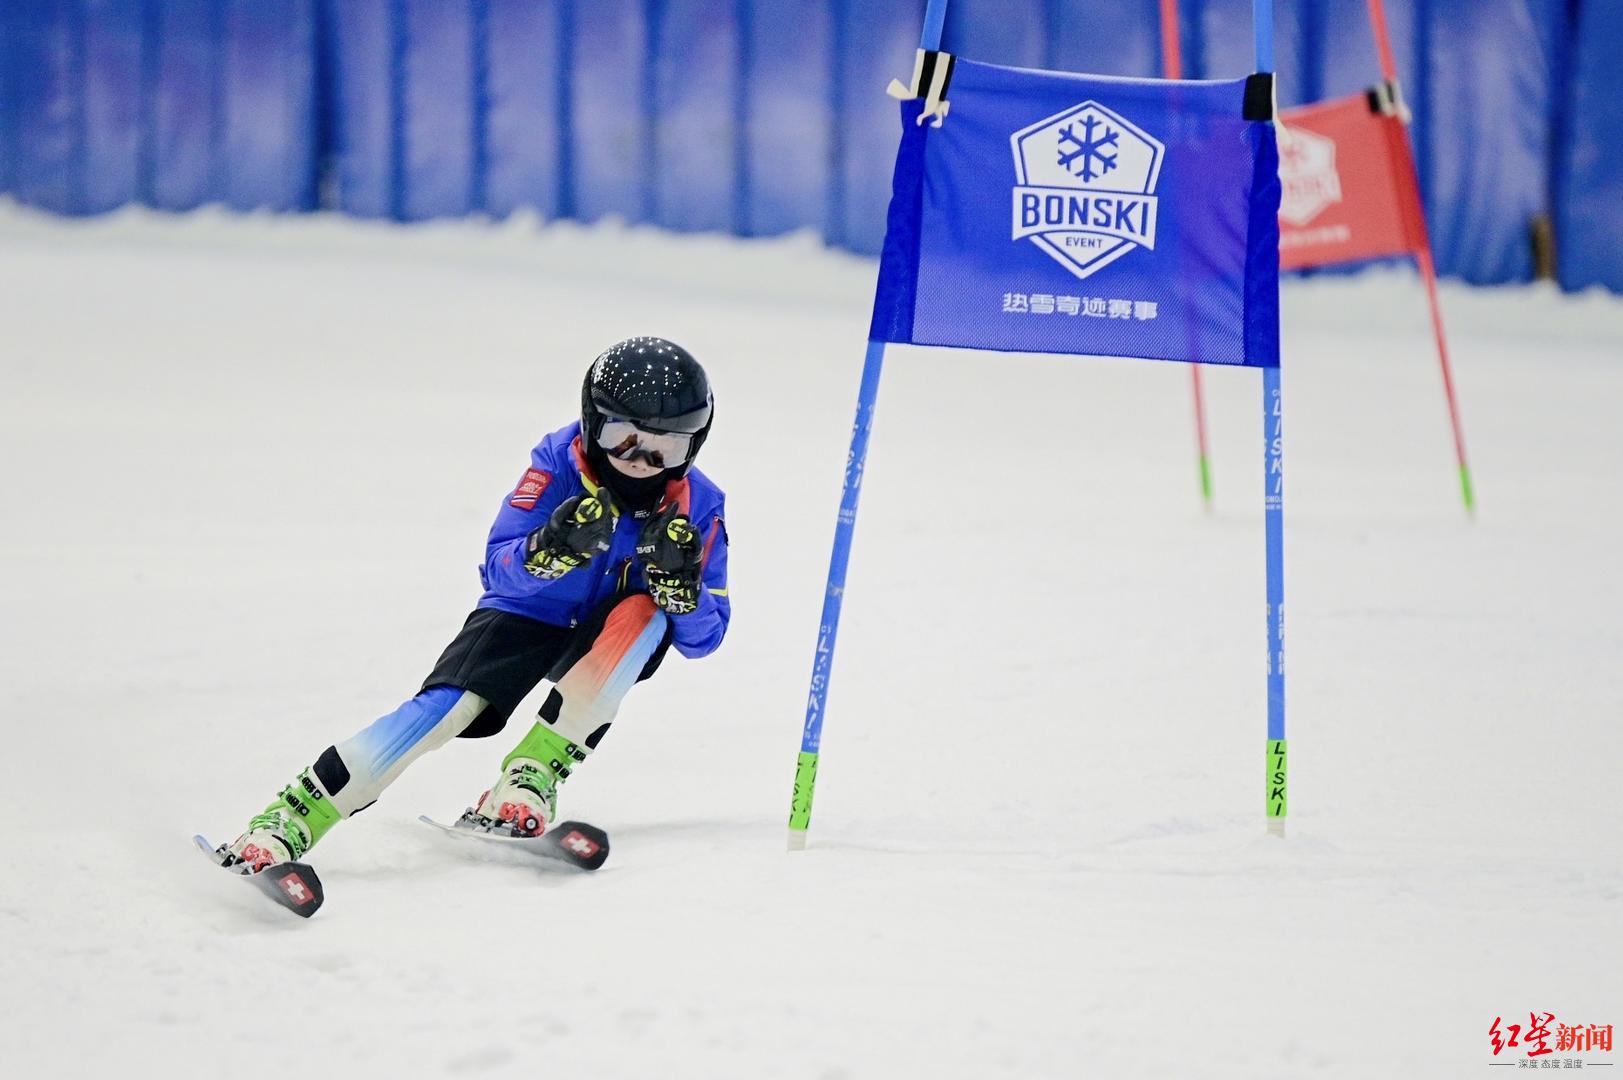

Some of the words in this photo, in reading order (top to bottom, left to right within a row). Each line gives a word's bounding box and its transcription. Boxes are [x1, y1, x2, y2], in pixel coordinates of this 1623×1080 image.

[1021, 193, 1149, 236] BONSKI
[1065, 236, 1103, 248] EVENT
[1003, 292, 1158, 320] 热雪奇迹赛事
[1271, 741, 1286, 817] LISKI
